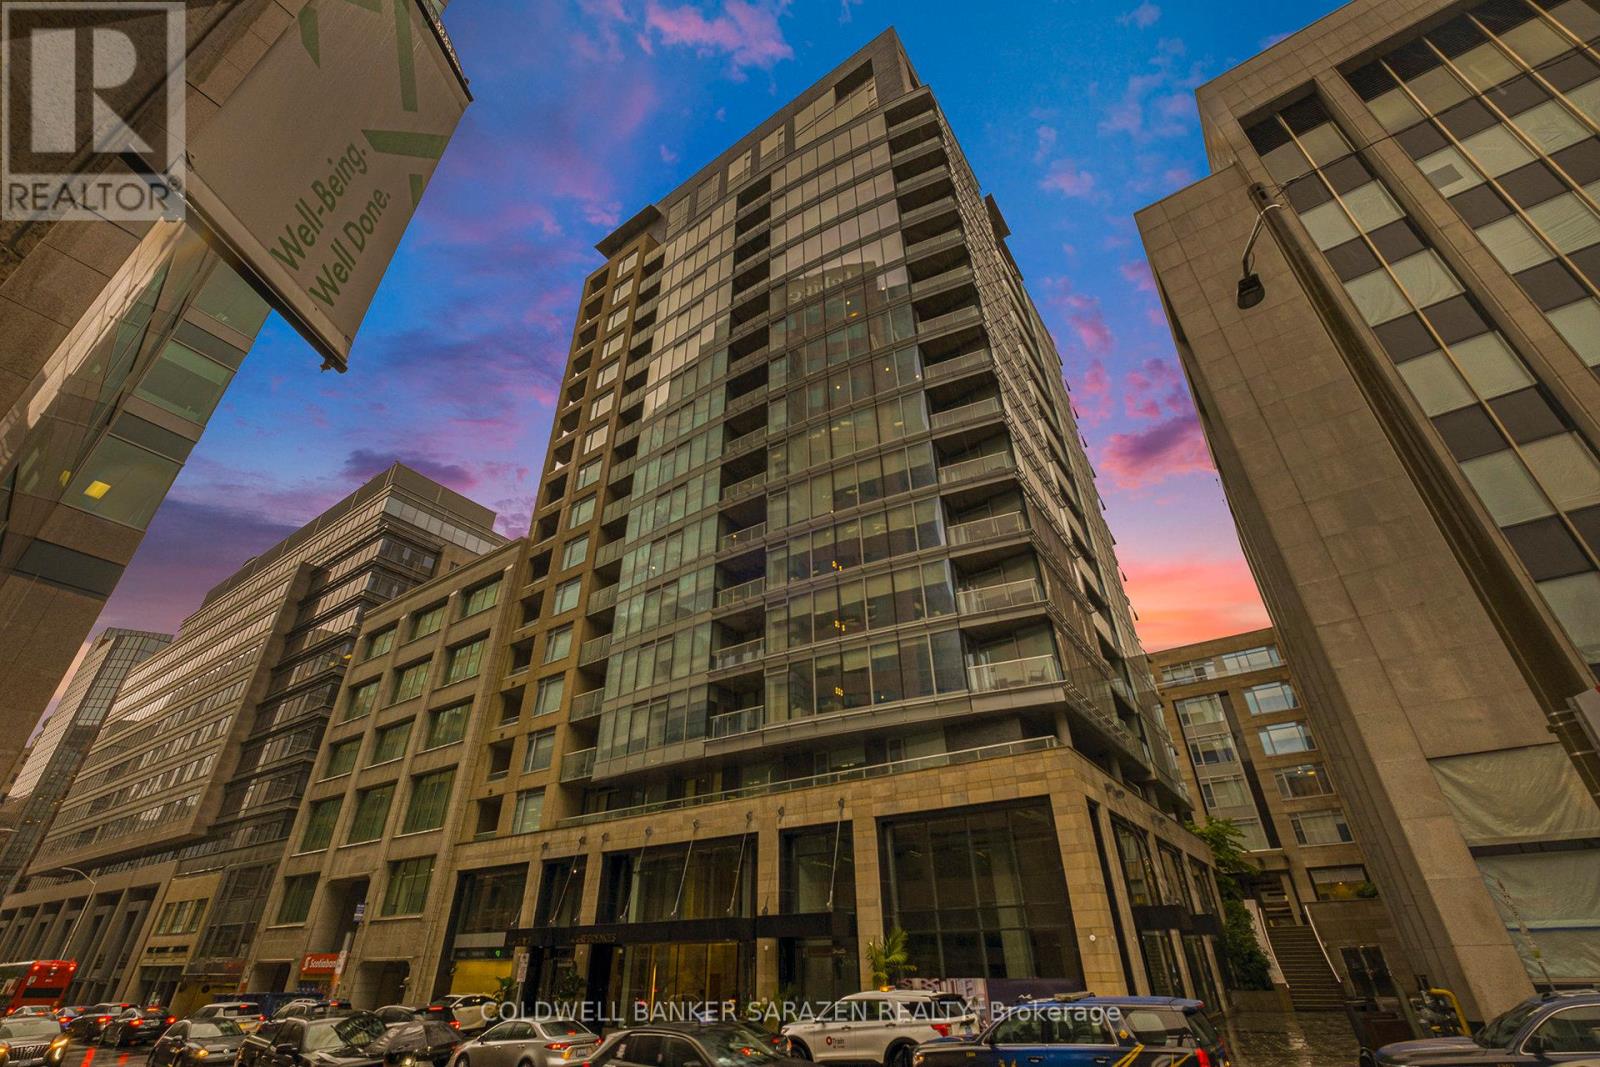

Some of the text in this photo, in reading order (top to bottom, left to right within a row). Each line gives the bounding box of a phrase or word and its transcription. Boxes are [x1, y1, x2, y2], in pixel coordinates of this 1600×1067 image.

[270, 143, 367, 271] Well-Being.
[309, 189, 391, 307] Well Done.
[310, 959, 336, 968] Scotiaban
